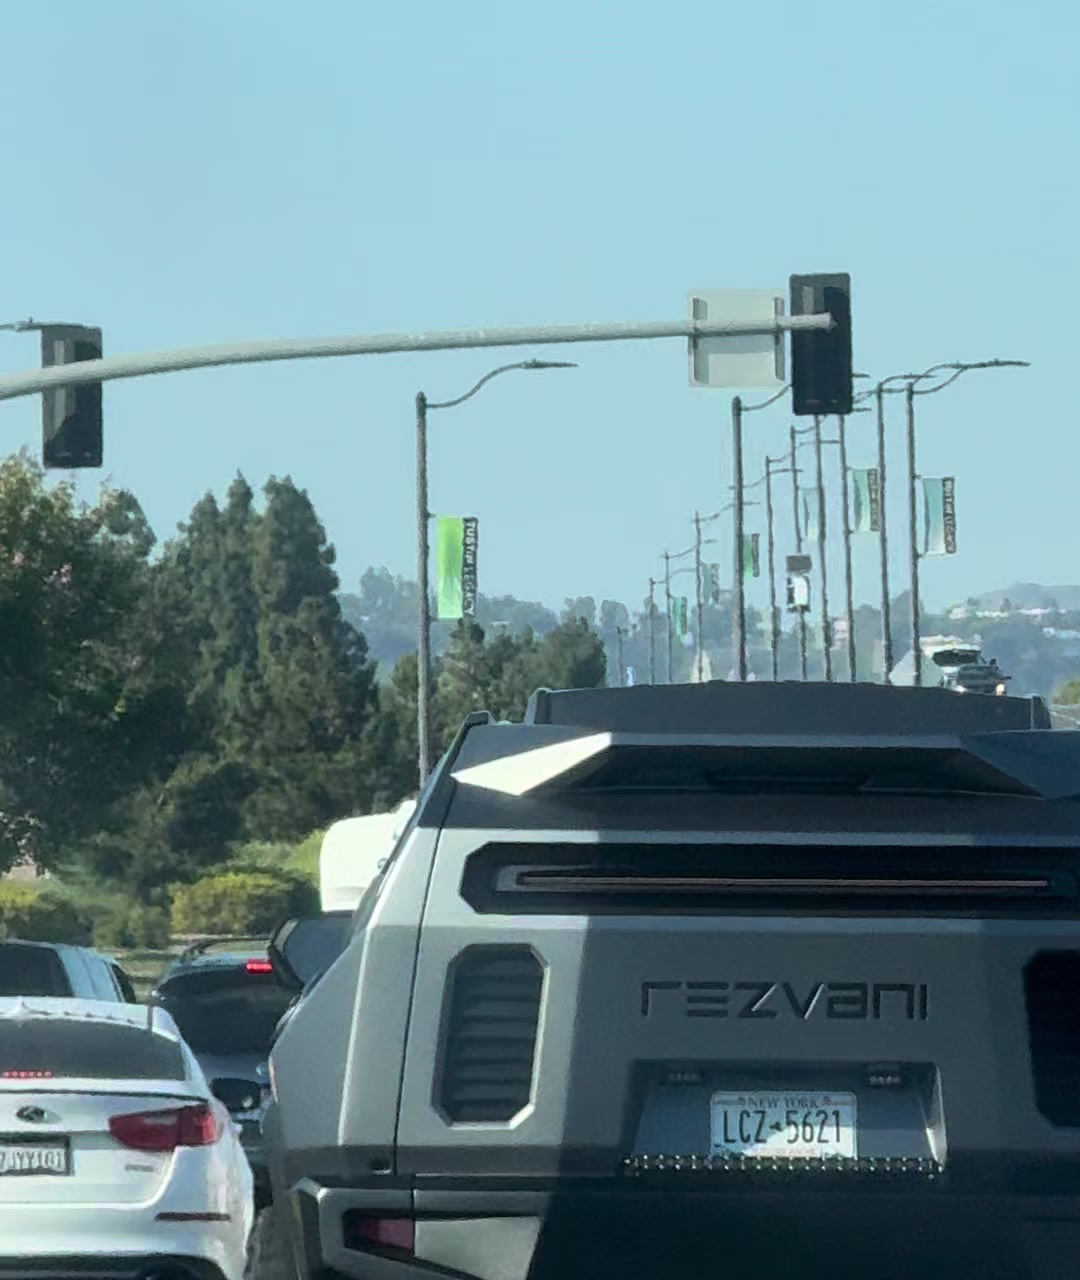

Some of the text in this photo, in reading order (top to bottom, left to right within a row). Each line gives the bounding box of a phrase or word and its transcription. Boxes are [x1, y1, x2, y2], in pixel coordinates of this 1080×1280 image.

[751, 1095, 780, 1109] NEW
[722, 1109, 841, 1144] LCZ 5621
